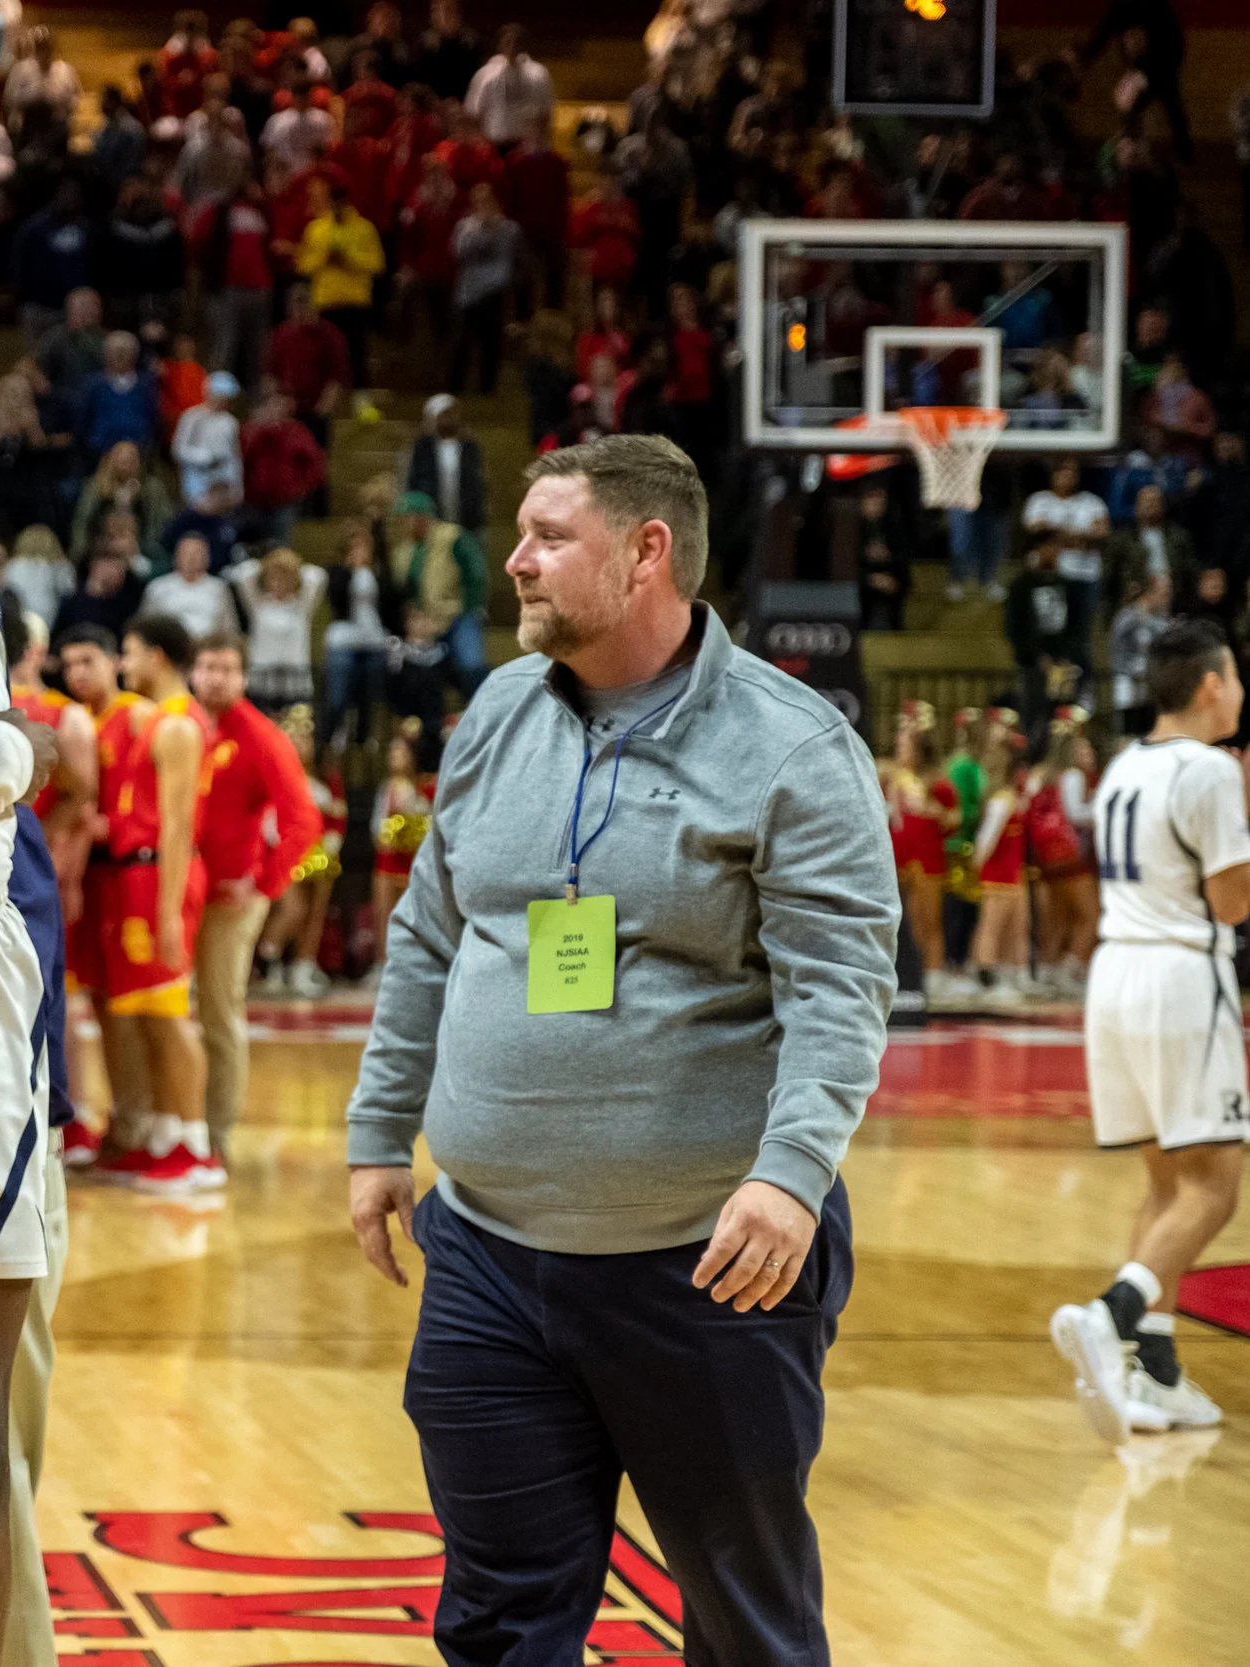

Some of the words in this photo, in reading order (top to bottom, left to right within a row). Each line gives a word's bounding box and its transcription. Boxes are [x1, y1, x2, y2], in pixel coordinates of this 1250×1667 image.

[1100, 787, 1142, 882] 11
[562, 933, 583, 943] 2019
[556, 948, 589, 958] NJSIAA
[558, 962, 586, 973] Coach
